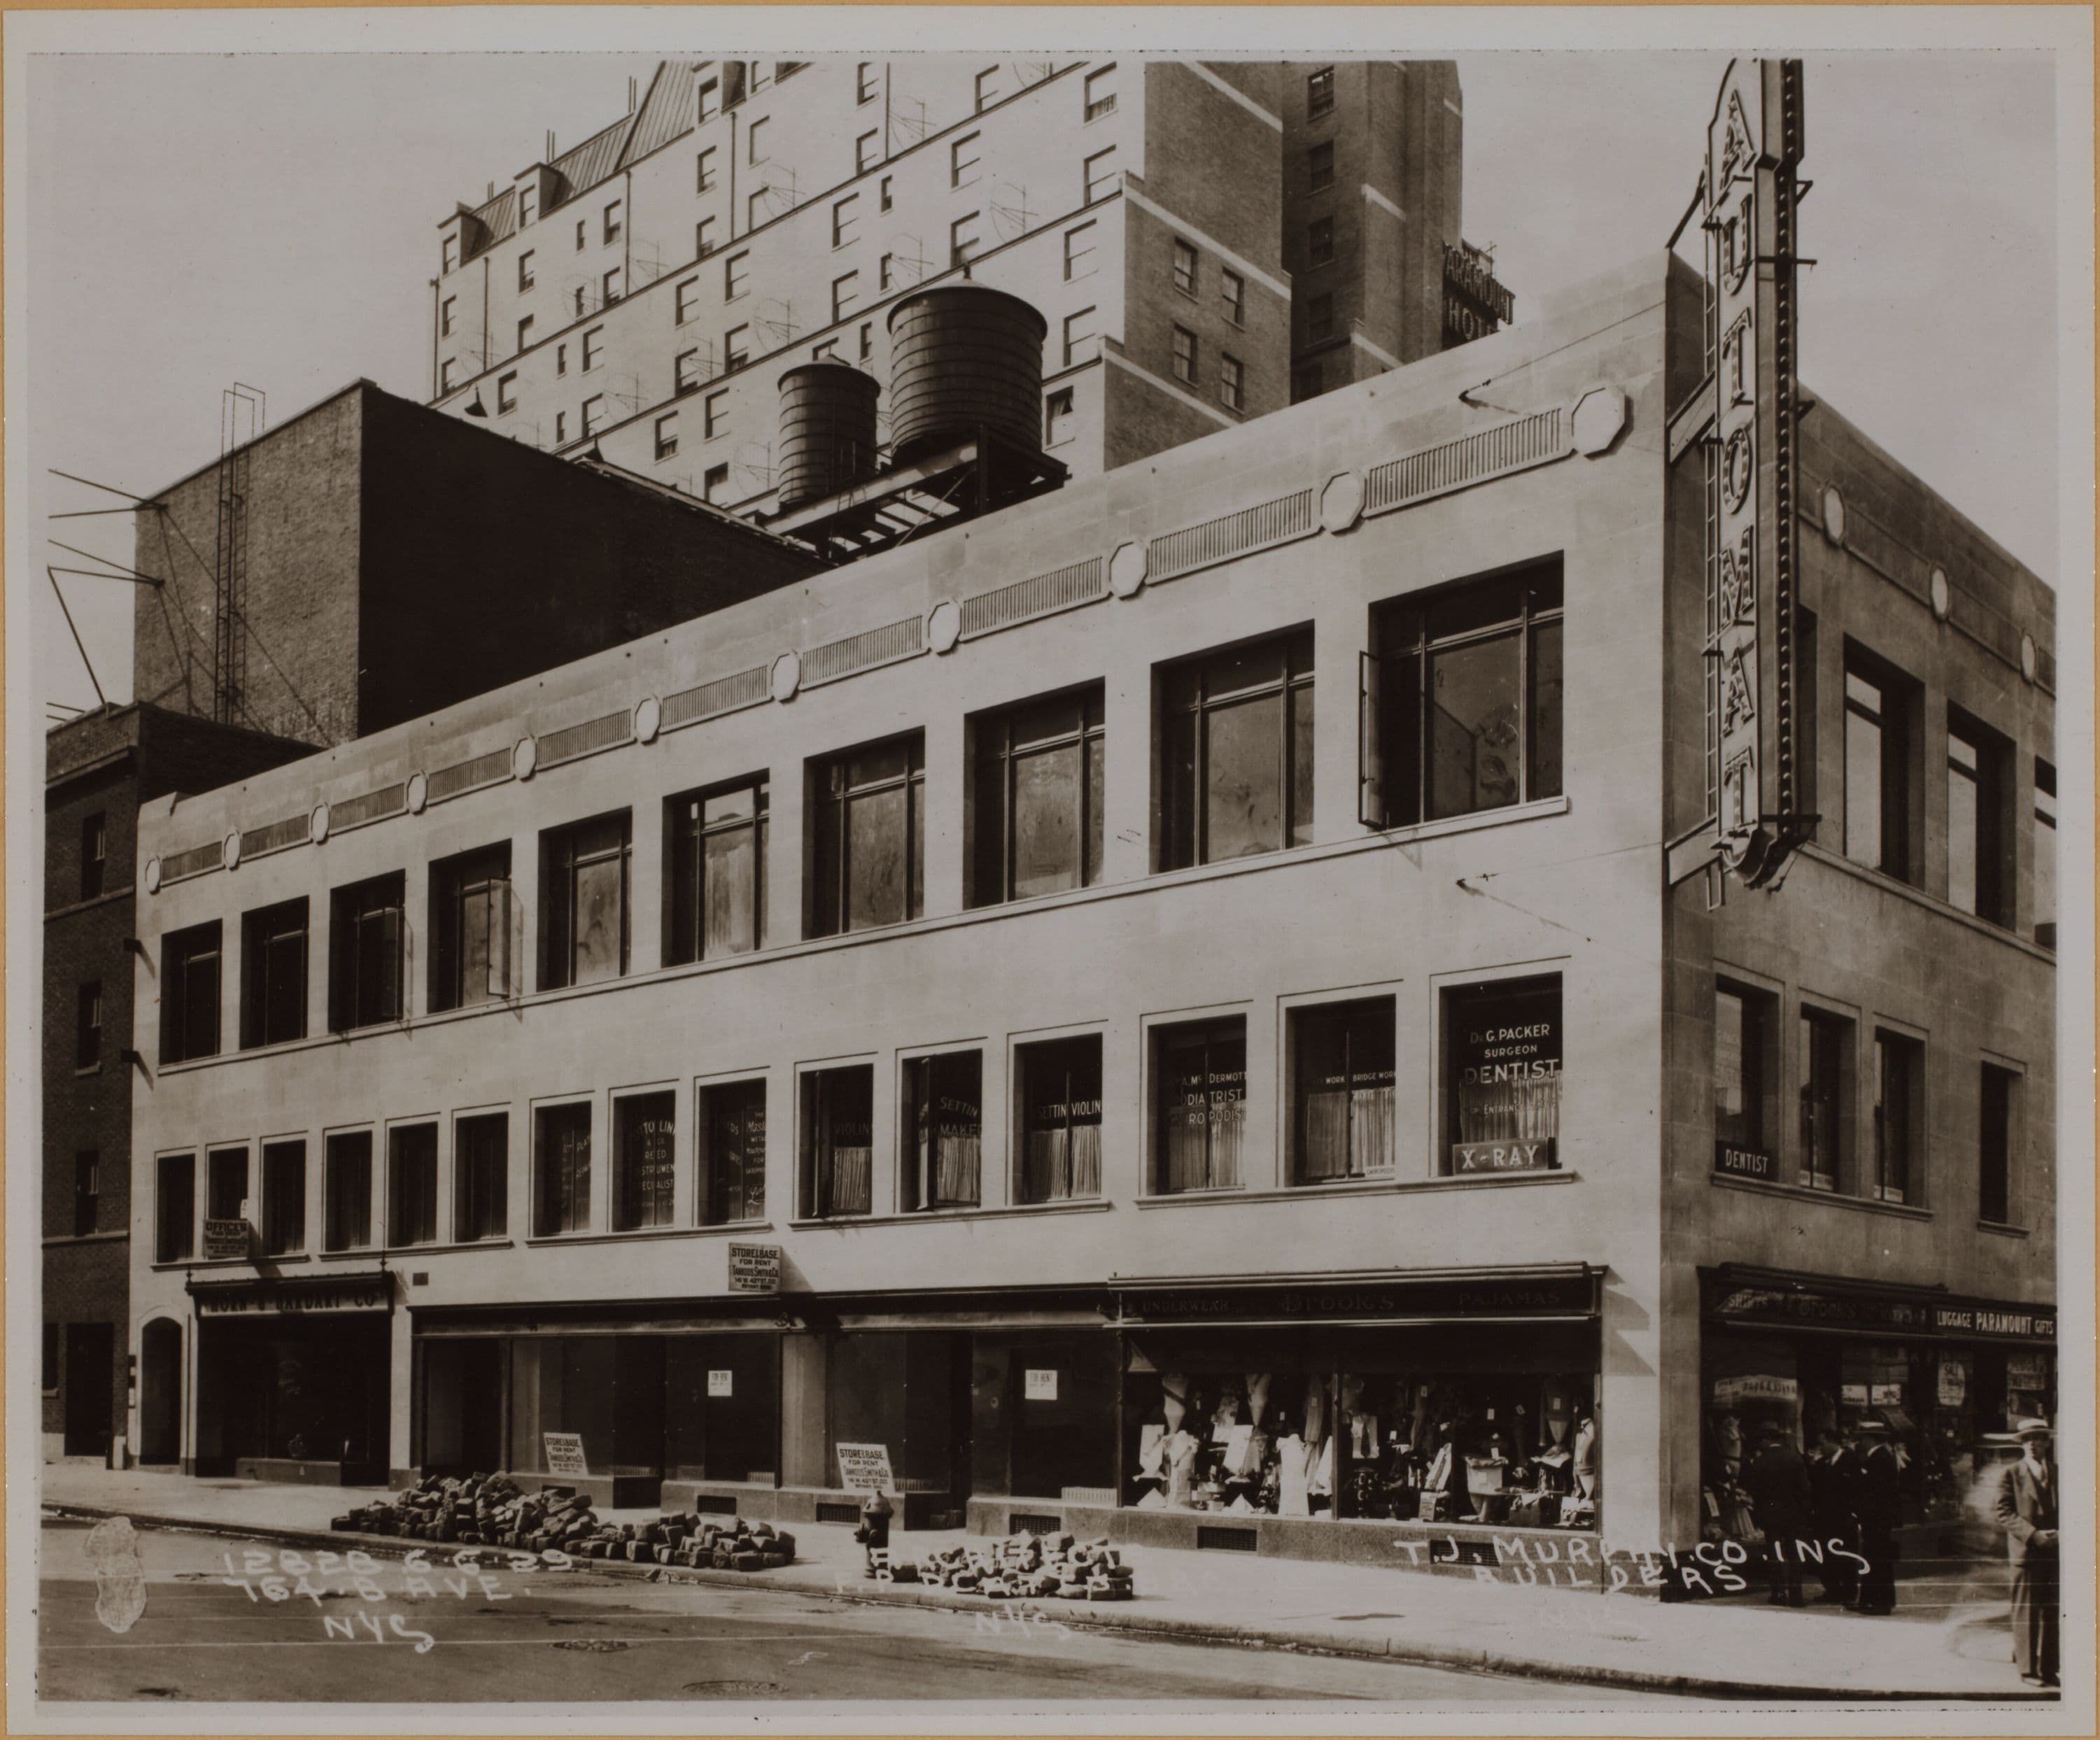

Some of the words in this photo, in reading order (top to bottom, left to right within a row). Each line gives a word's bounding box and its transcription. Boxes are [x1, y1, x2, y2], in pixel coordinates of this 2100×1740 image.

[1719, 88, 1756, 830] AUTOMAT
[1499, 1024, 1550, 1040] PACKER
[1484, 1045, 1538, 1059] SURGEON
[1326, 1076, 1345, 1084] WORK
[1353, 1073, 1376, 1082] BRIDGE
[1465, 1059, 1560, 1085] DENTIST
[1461, 1145, 1539, 1170] X-RAY
[1725, 1148, 1769, 1175] DENTIST
[206, 1222, 247, 1233] OFFICES
[211, 1298, 247, 1313] HORN
[276, 1295, 339, 1310] HARDART
[1458, 1292, 1560, 1306] PAJAMAS
[1936, 1310, 1972, 1328] LUGGAGE
[1975, 1310, 2033, 1336] PARAMOUNT
